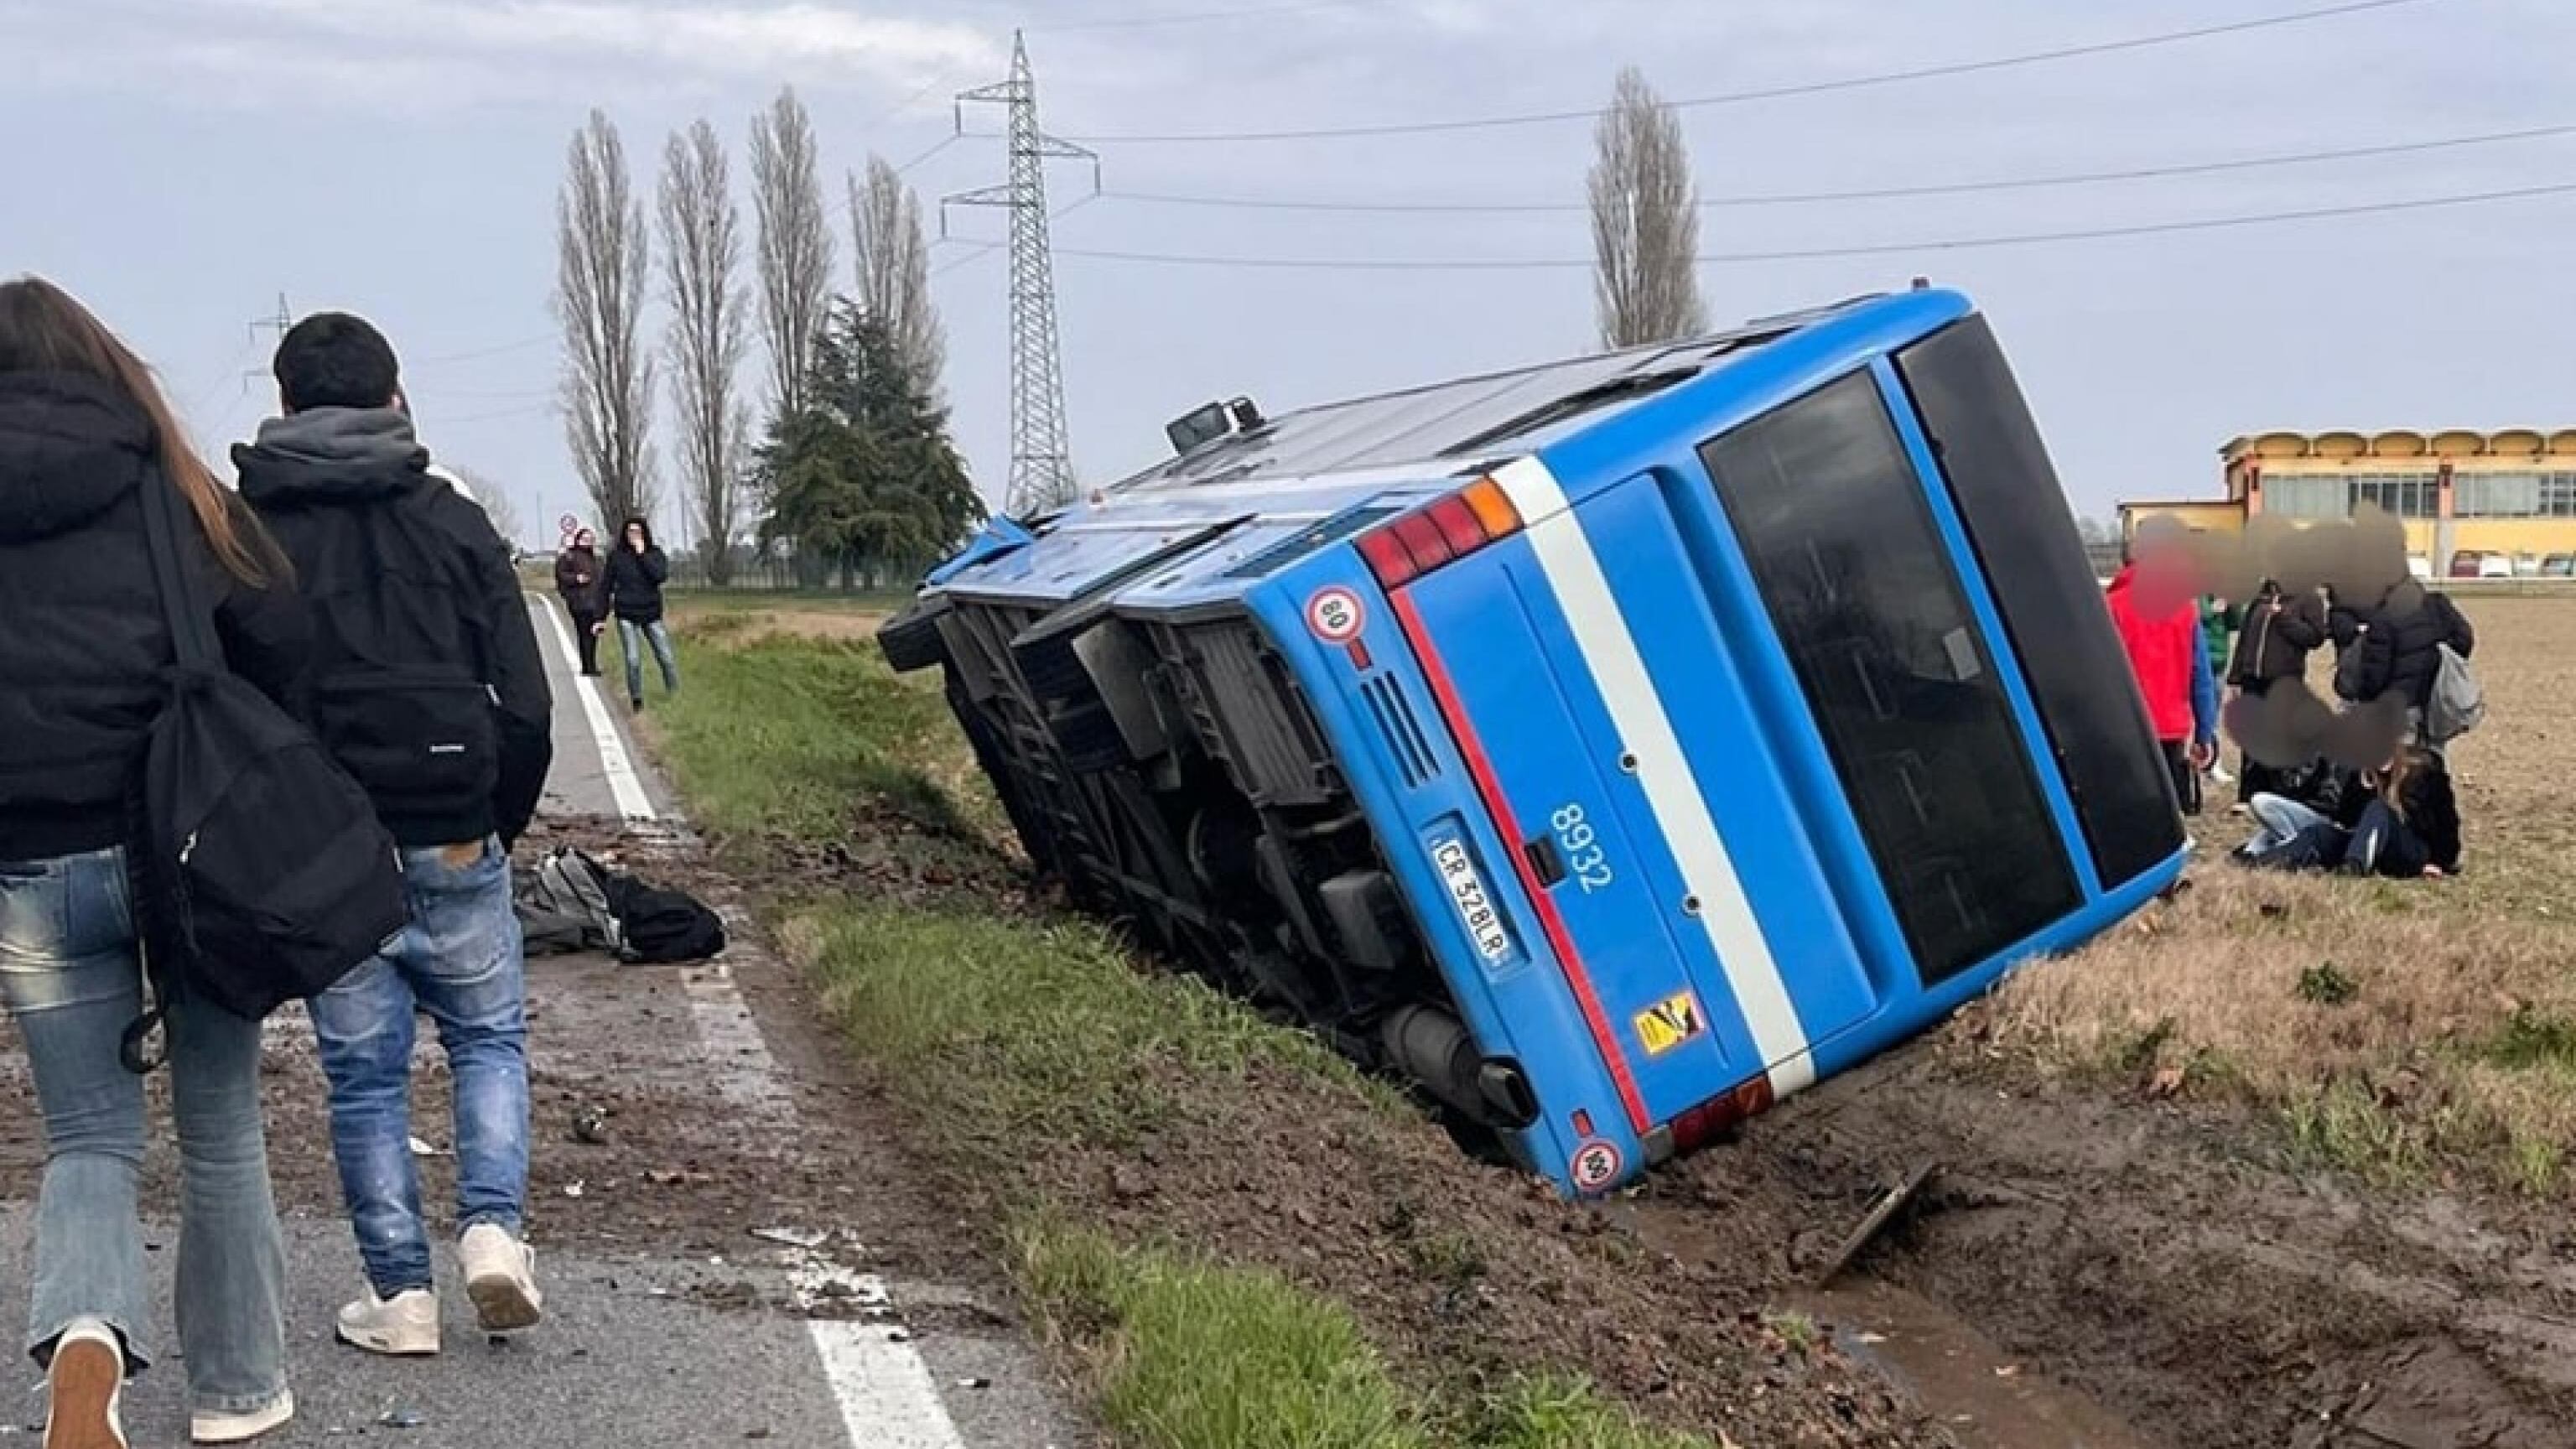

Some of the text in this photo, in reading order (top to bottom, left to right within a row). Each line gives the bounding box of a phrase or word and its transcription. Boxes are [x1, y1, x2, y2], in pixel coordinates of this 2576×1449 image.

[1322, 600, 1349, 629] 80
[1551, 802, 1613, 894] 8932
[1438, 845, 1504, 953] CR 328LR
